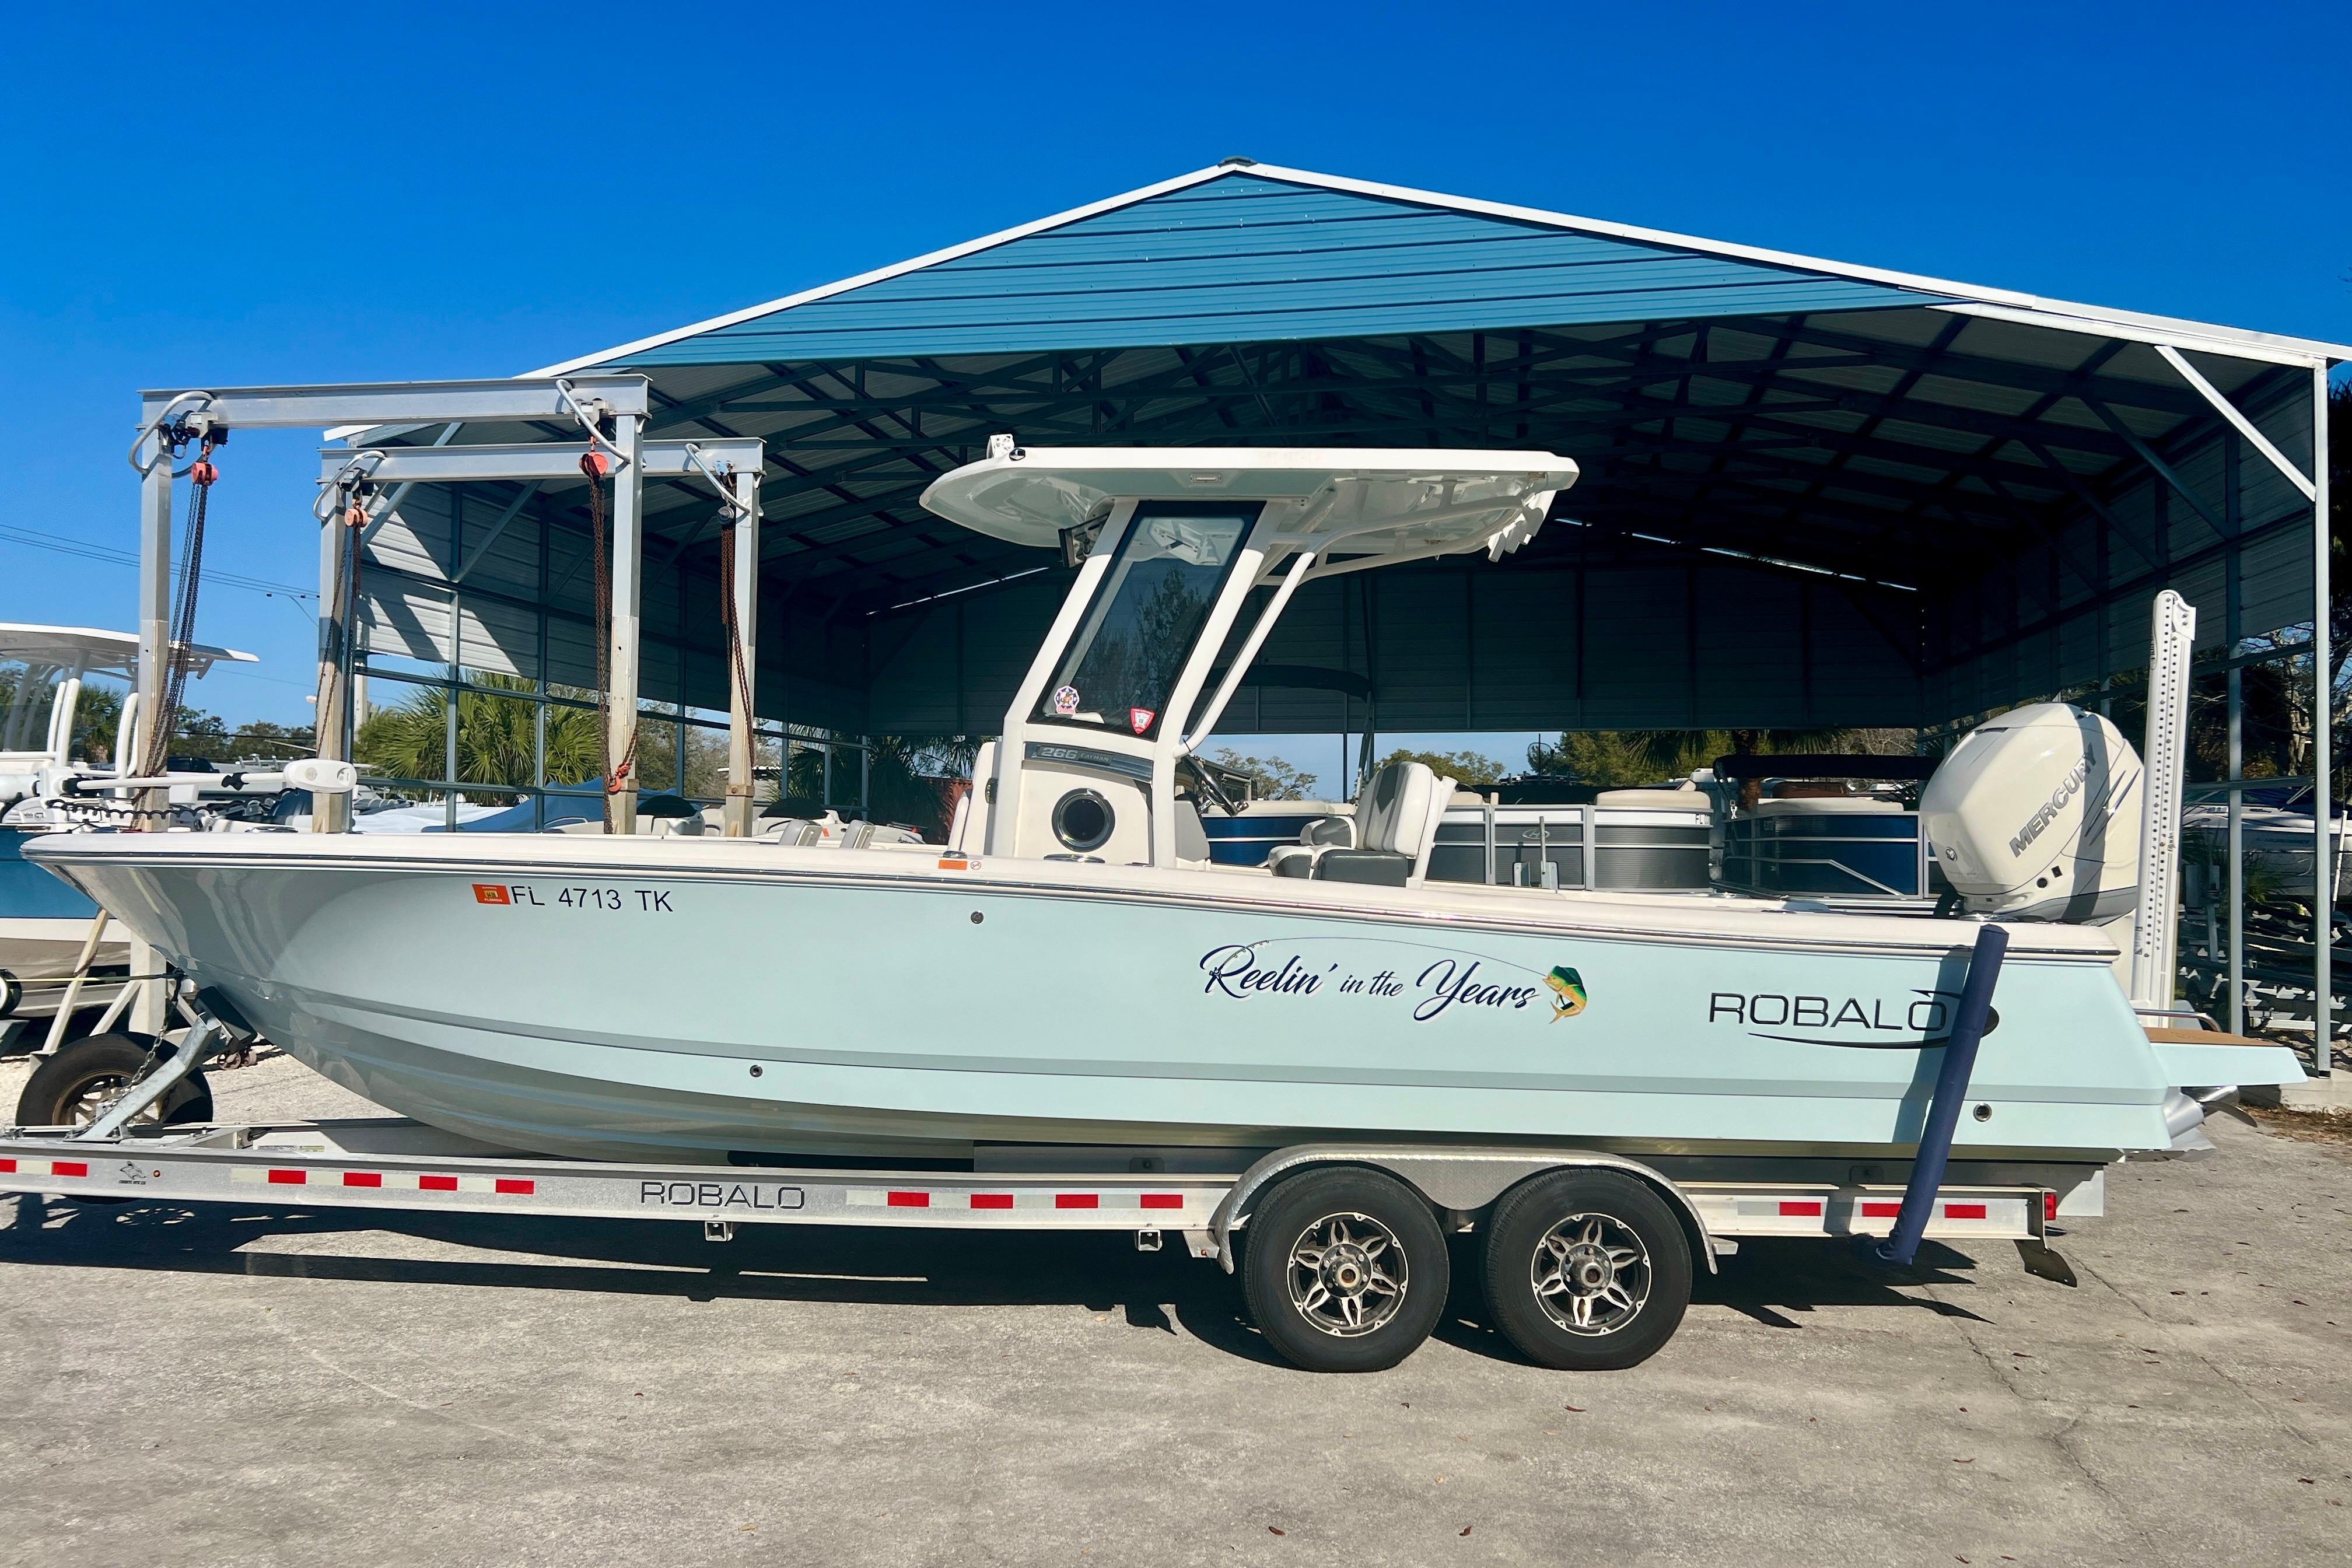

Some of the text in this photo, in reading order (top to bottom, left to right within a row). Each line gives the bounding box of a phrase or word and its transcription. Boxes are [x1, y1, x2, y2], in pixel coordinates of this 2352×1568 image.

[1041, 747, 1110, 762] 266 CAYMAN
[2008, 742, 2096, 858] MERCURY
[511, 886, 673, 912] FL 4713 TK
[1199, 944, 1541, 1022] Reelin' in the Years
[1709, 992, 1947, 1032] ROBALO
[641, 1181, 805, 1210] ROBALO
